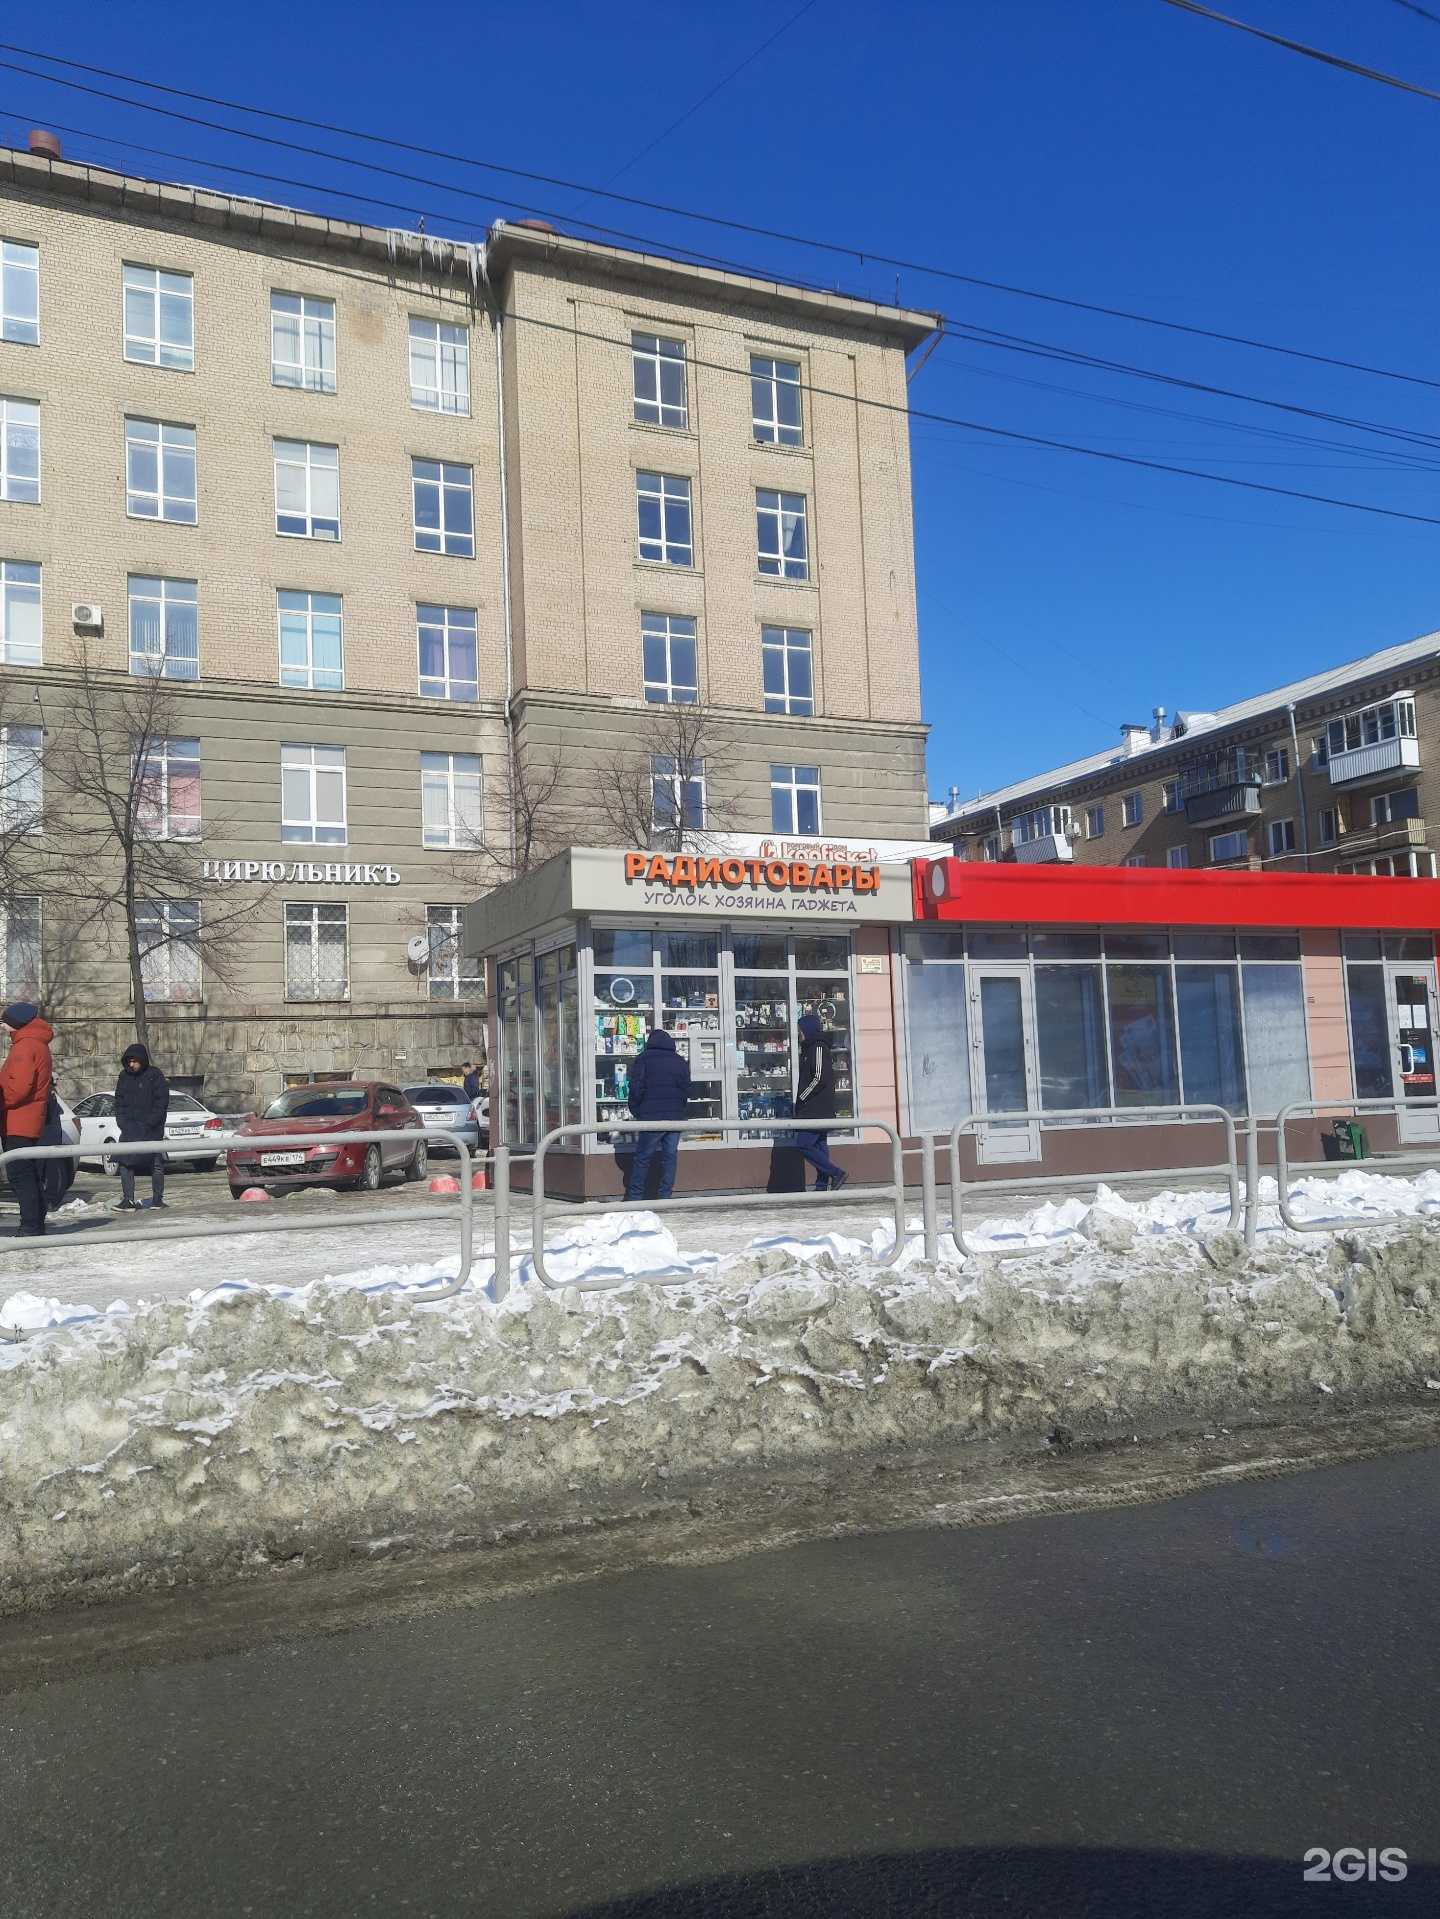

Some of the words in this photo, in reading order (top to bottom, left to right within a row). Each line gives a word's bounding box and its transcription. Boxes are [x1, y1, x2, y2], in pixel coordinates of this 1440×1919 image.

[202, 860, 401, 886] ЦИРЮЛЬНИКЪ
[625, 852, 881, 891] РАДИОТОВАРЫ
[644, 891, 711, 907] УГОЛОК
[715, 894, 787, 910] ХОЗЯИНА
[791, 898, 858, 913] ГАДЖЕТА
